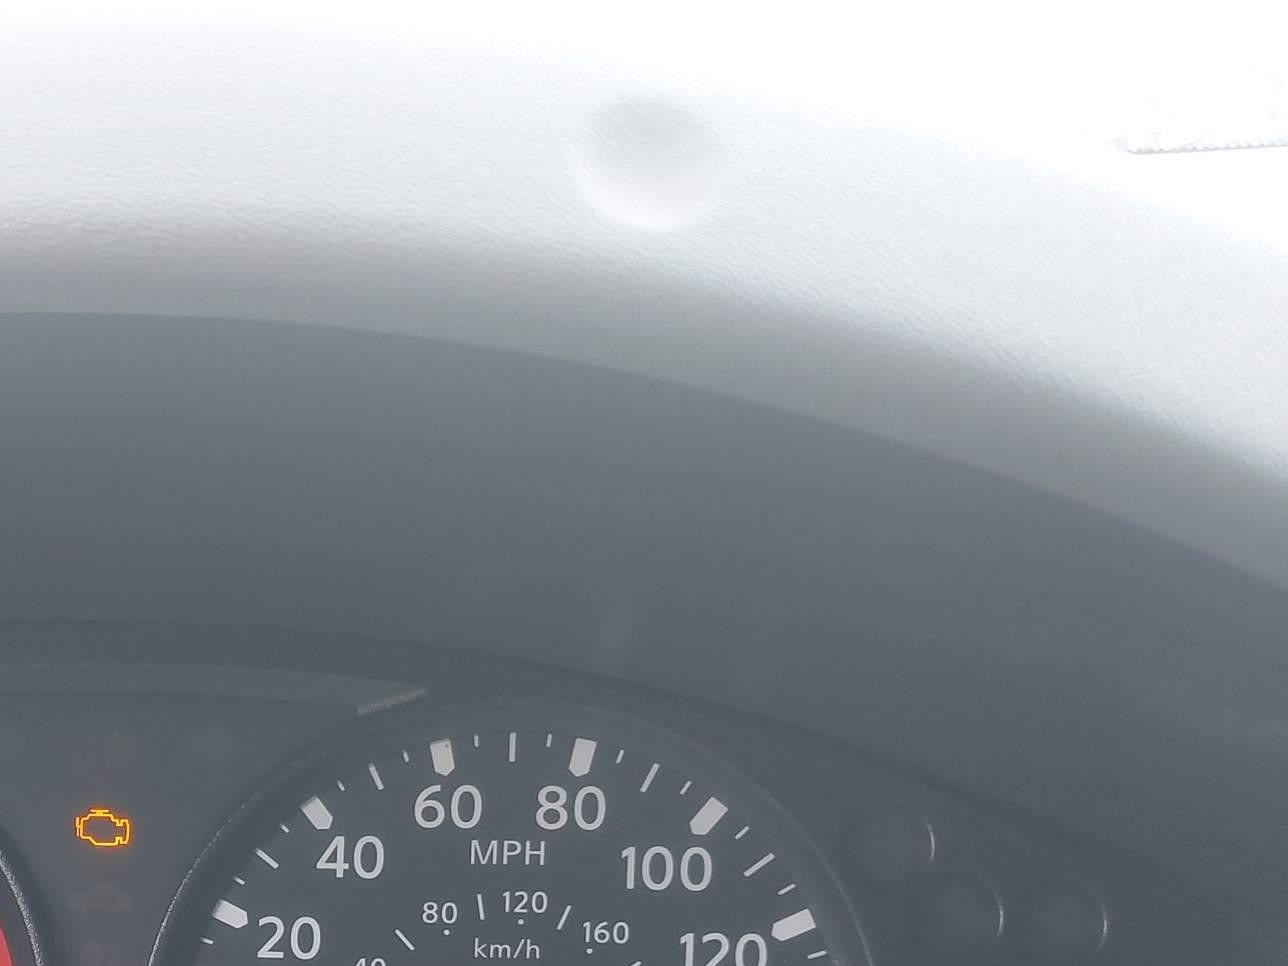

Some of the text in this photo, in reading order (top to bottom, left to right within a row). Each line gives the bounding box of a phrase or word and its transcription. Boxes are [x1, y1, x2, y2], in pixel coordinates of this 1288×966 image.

[414, 784, 483, 829] 60
[535, 785, 607, 831] 80
[316, 835, 385, 880] 40
[470, 839, 546, 866] MPH
[621, 845, 713, 892] 100
[422, 901, 458, 924] 80
[502, 891, 548, 914] 120
[257, 915, 321, 960] 20
[474, 937, 540, 960] km/h
[582, 921, 629, 944] 160
